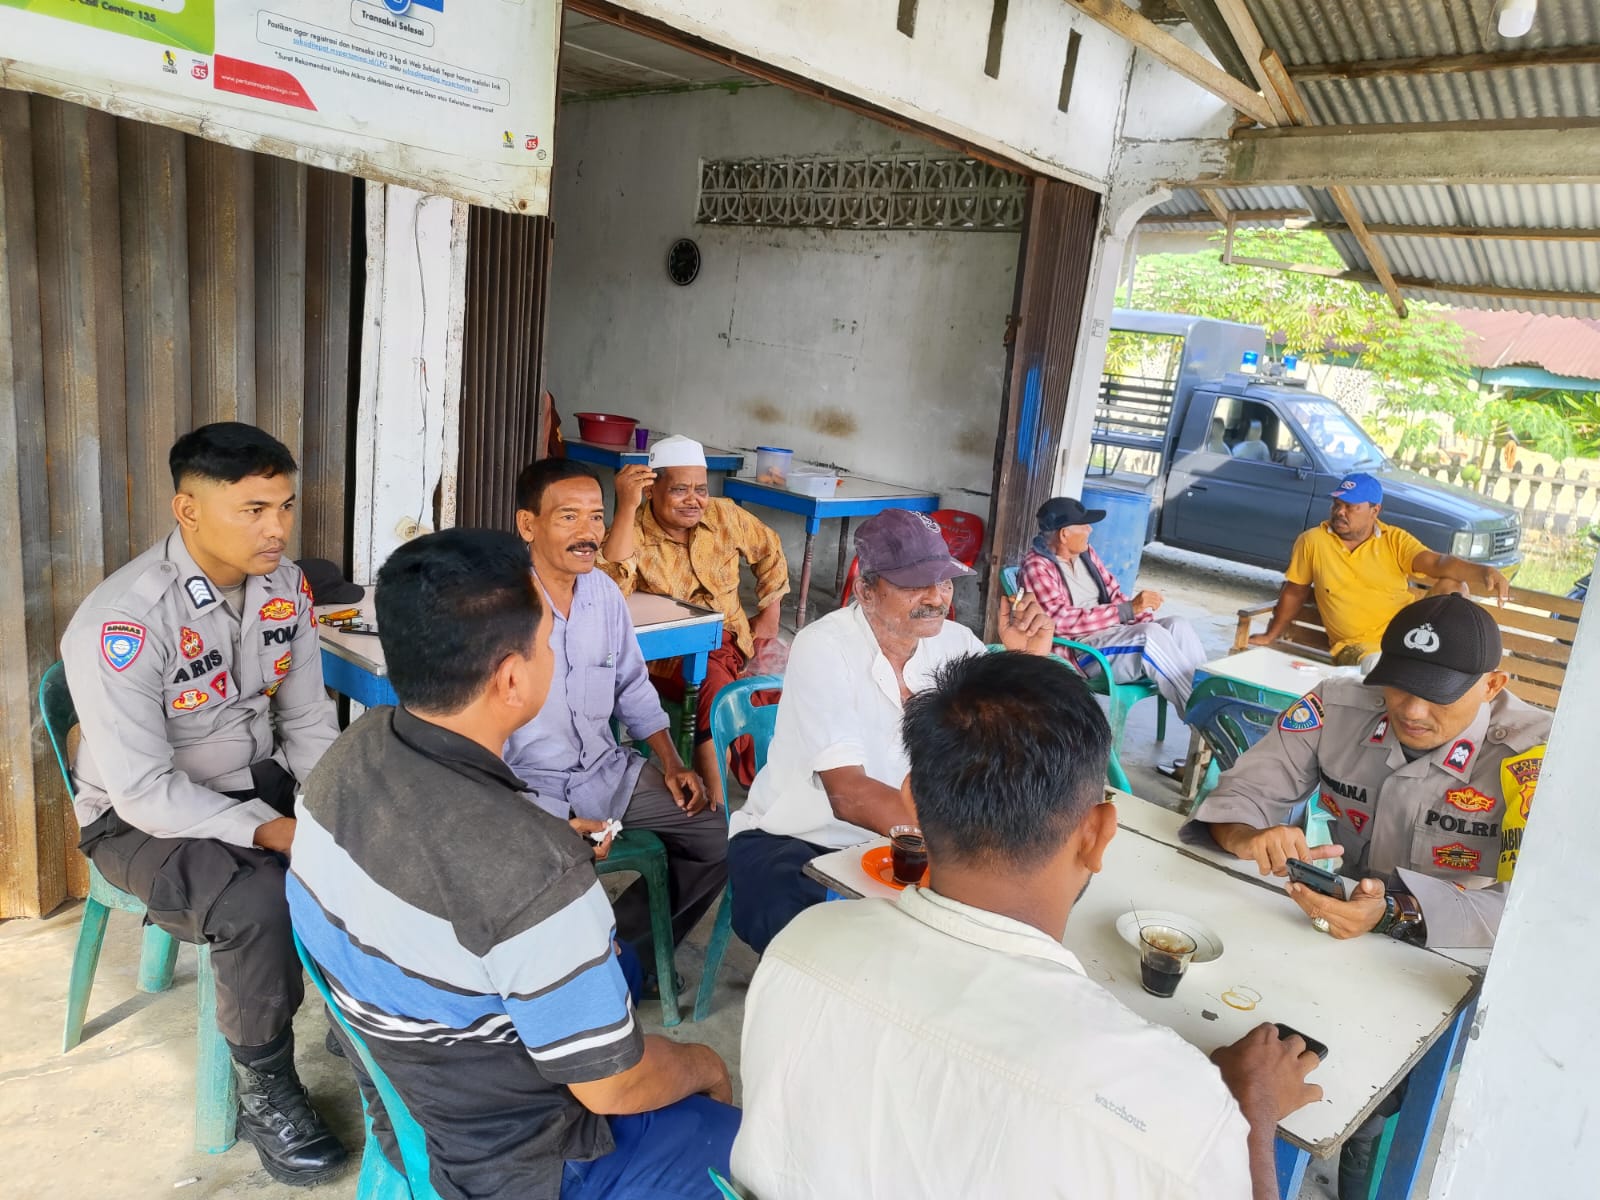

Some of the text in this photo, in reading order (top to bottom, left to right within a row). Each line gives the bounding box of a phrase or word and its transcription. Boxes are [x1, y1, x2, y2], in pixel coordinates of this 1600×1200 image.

[101, 1, 135, 17] Center
[138, 10, 157, 22] 135
[361, 10, 425, 36] Transaksi Selesai
[267, 19, 292, 33] Pastikan
[293, 28, 308, 37] agar
[310, 33, 338, 46] registrasi
[338, 39, 350, 49] dan
[376, 50, 388, 60] LPG
[394, 55, 402, 65] kg
[409, 59, 422, 69] Web
[295, 56, 332, 72] Rekomendasi
[173, 649, 223, 684] ARIS
[1424, 809, 1499, 838] POLRI
